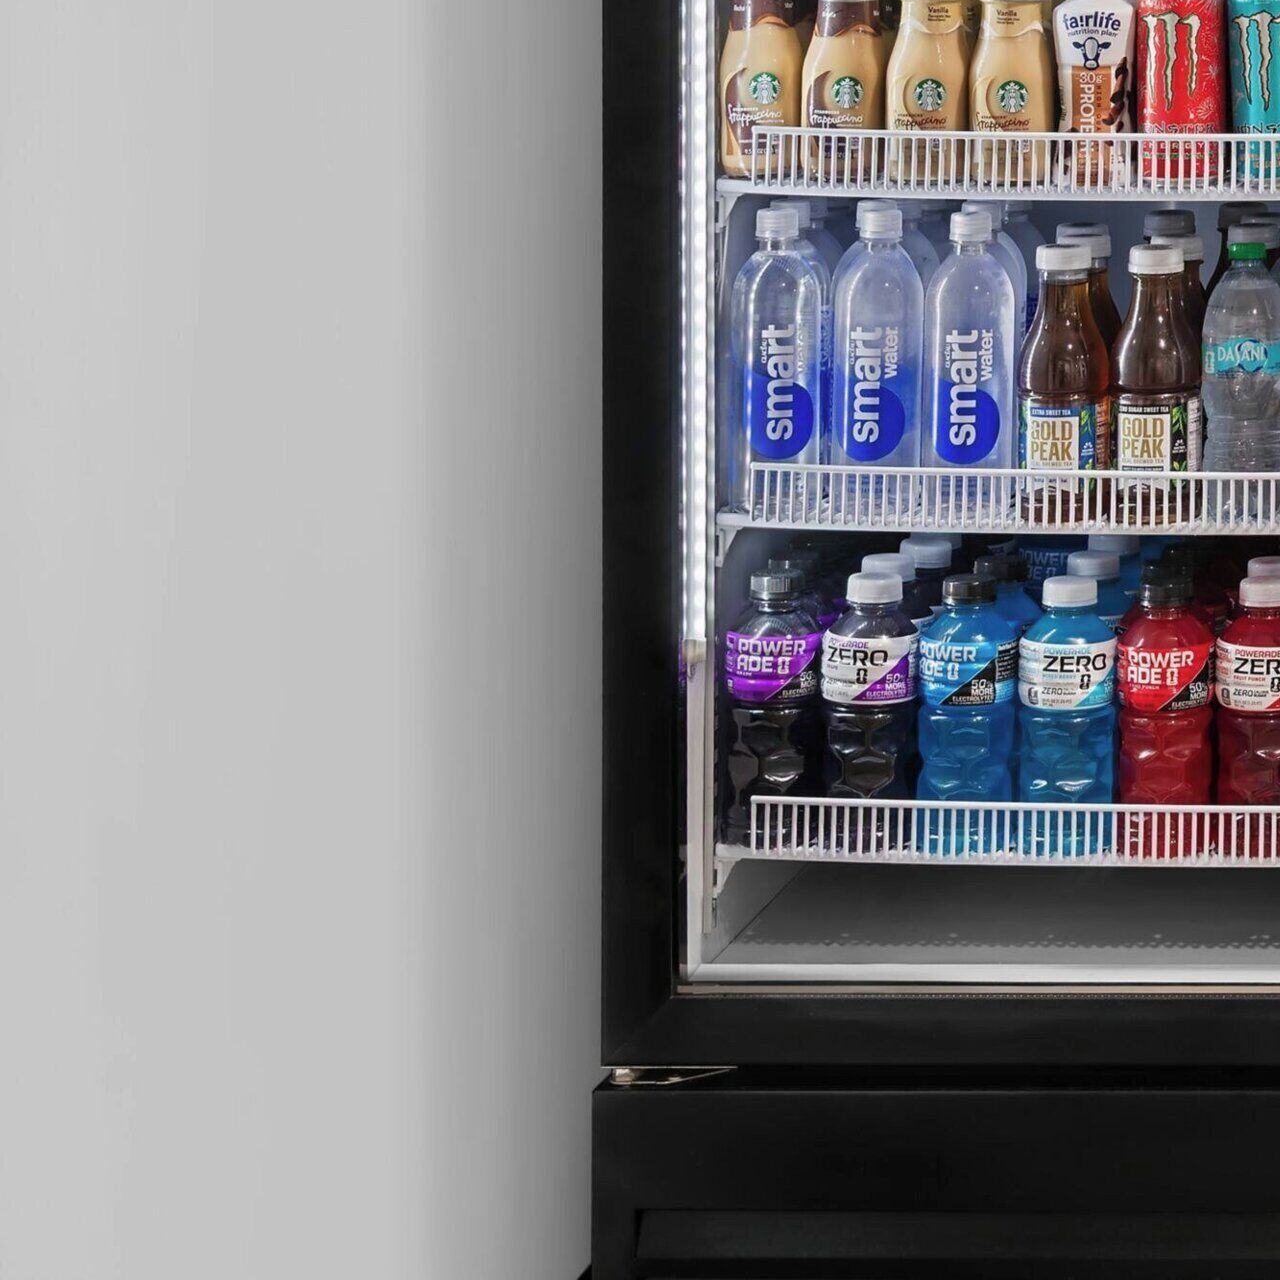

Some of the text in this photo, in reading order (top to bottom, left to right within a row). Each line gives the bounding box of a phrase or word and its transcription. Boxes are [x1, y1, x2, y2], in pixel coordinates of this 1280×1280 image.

[1217, 345, 1265, 364] DASANI
[762, 324, 794, 440] smart
[850, 326, 882, 443] smart
[946, 328, 978, 446] smart
[1031, 419, 1073, 441] GOLD
[1122, 418, 1164, 438] GOLD
[1030, 441, 1074, 462] PEAK
[1122, 438, 1165, 459] PEAK
[737, 637, 806, 657] POWER
[1042, 654, 1106, 672] ZERO
[1128, 649, 1194, 668] POWER
